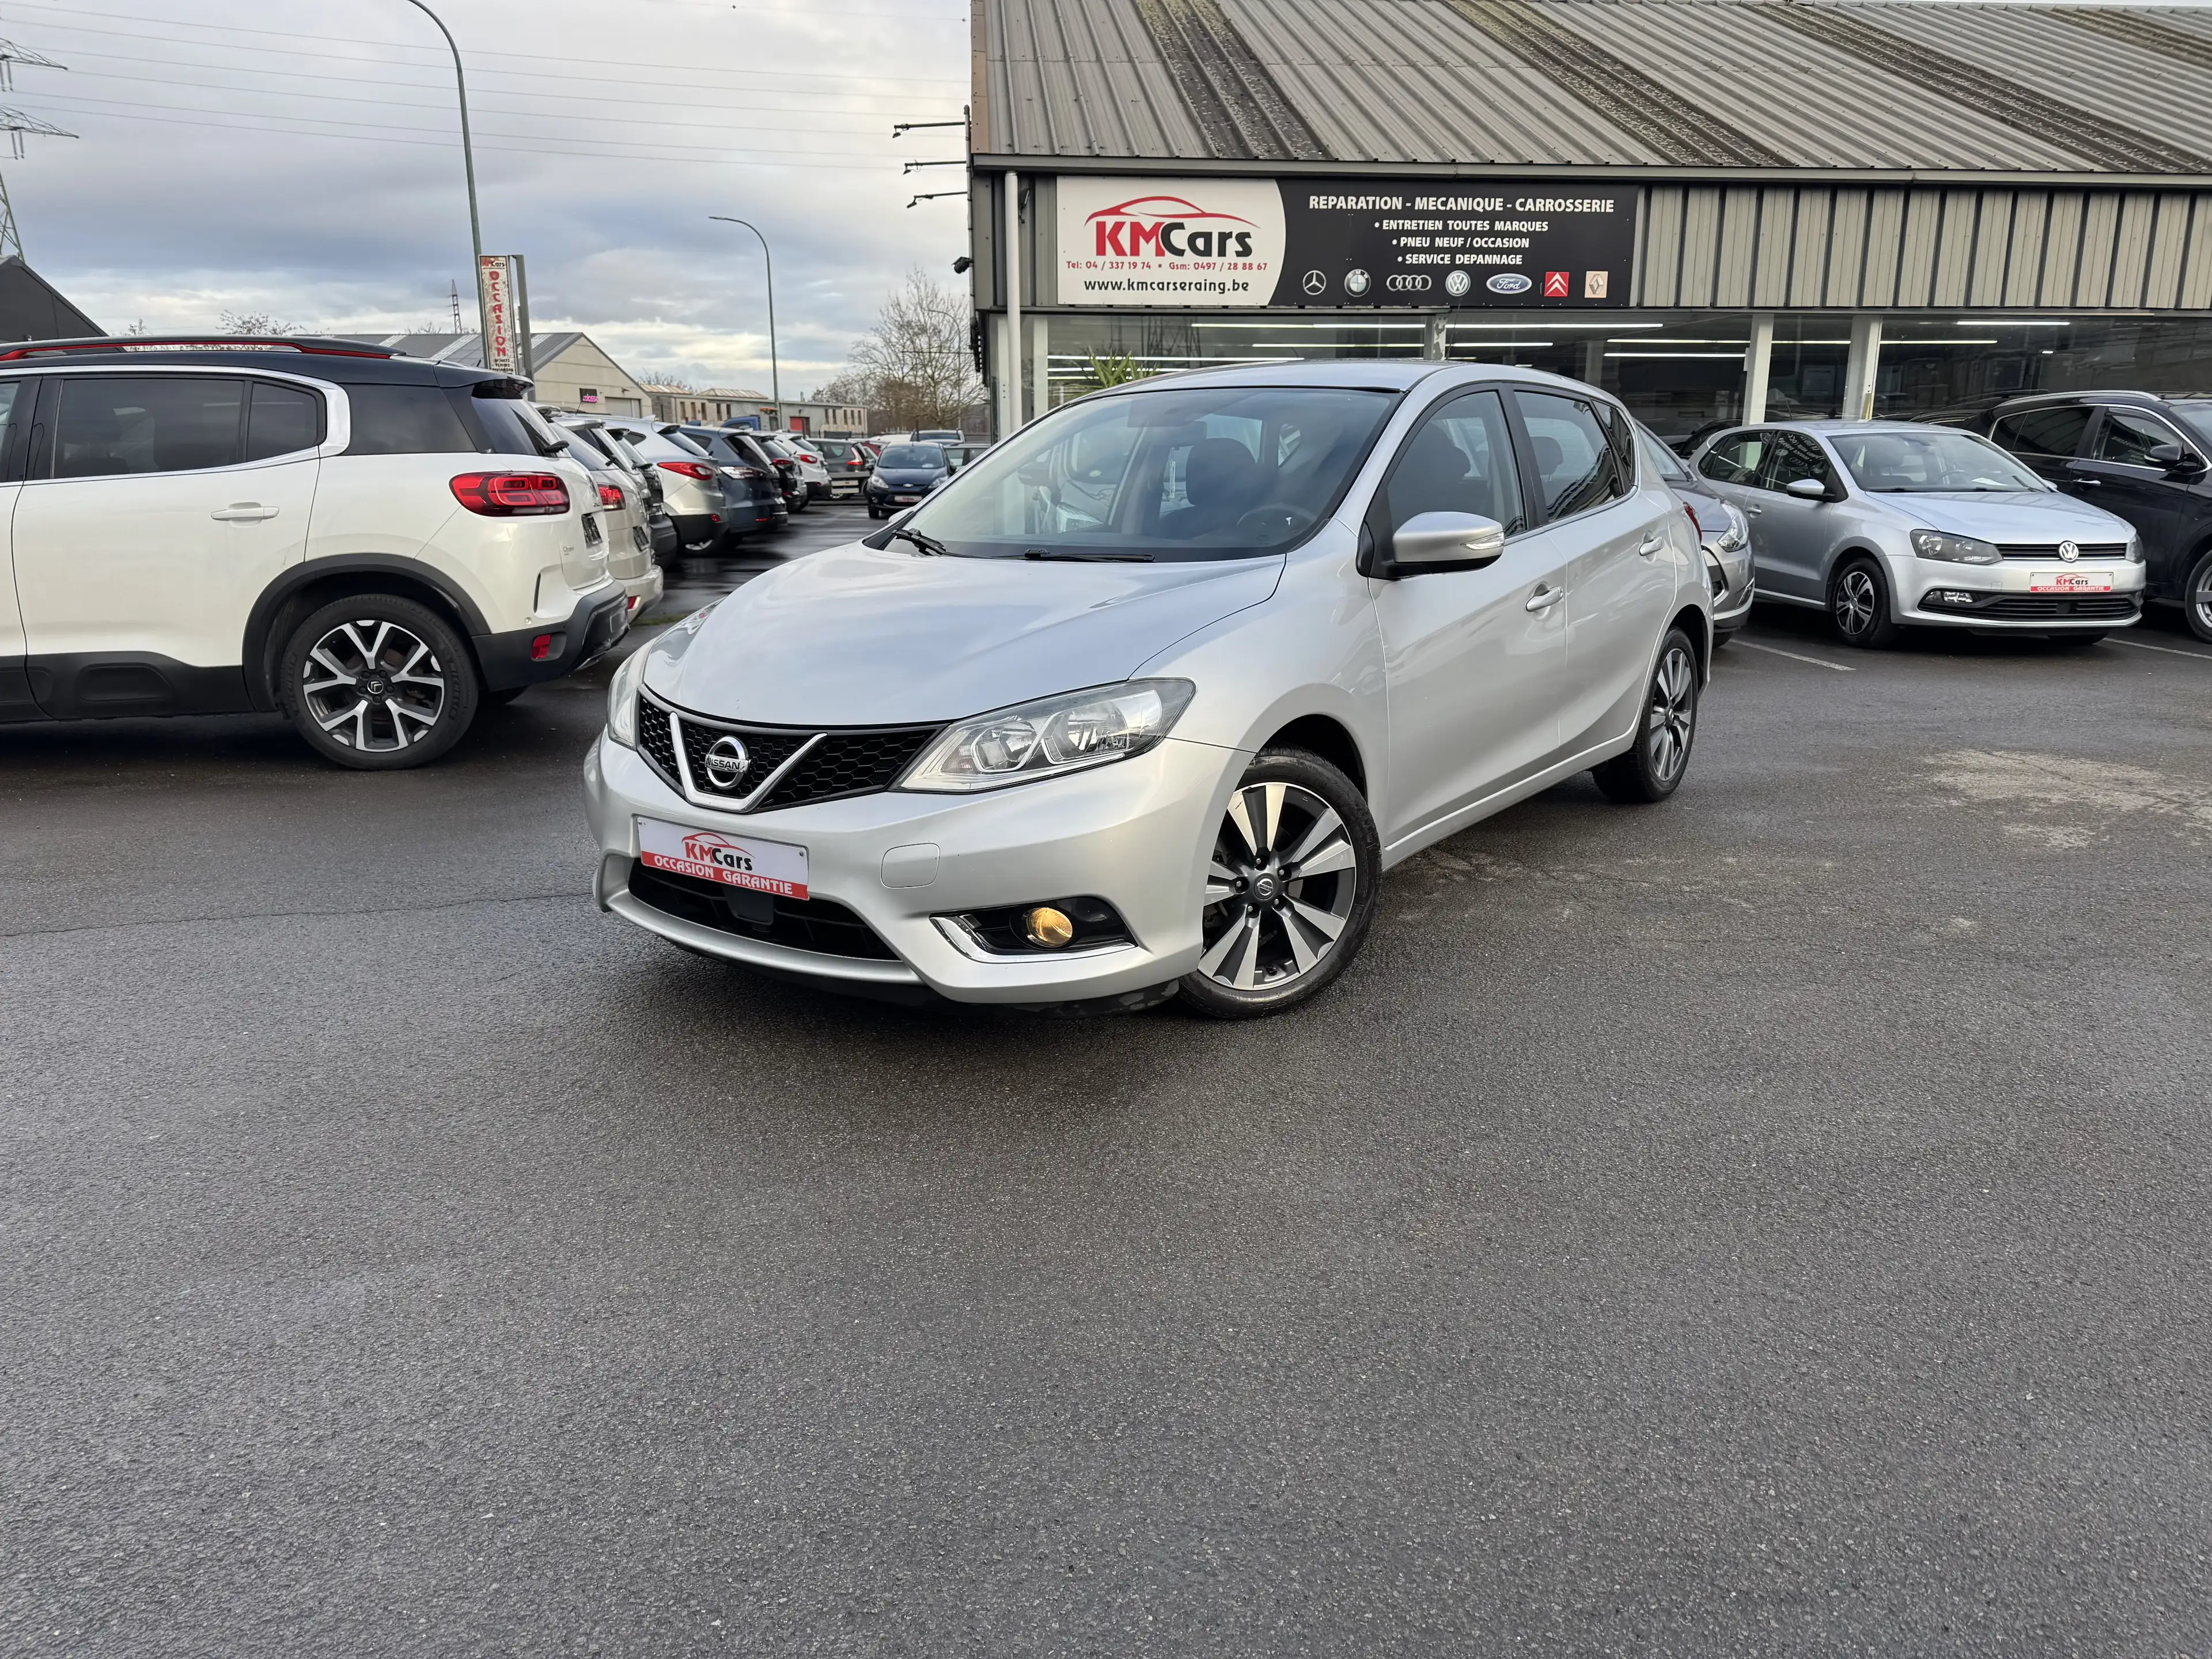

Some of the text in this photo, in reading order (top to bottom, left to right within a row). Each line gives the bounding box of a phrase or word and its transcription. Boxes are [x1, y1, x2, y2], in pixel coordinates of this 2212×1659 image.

[1309, 196, 1402, 209] REPARATION
[1414, 197, 1503, 213] MECANIQUE
[1515, 198, 1614, 213] CARROSSERIE
[1382, 219, 1548, 232] ENTRETIEN TOUTES MARQUES
[1096, 221, 1253, 257] KMCars
[1400, 237, 1430, 247] PNEU
[1435, 237, 1464, 247] NEUF
[1472, 237, 1529, 248] OCCASION
[1066, 261, 1082, 269] Tel:
[1085, 261, 1097, 269] 04
[1109, 262, 1124, 270] 337
[1127, 262, 1137, 270] 19
[1141, 262, 1151, 270] 74
[1169, 262, 1190, 270] Gsm:
[1194, 262, 1216, 270] 0497
[1227, 262, 1237, 270] 28
[1257, 263, 1267, 271] 67
[1405, 254, 1522, 264] SERVICE DEPANNAGE
[1084, 278, 1249, 294] www.kmcarseraing.be
[1497, 278, 1521, 290] Ford
[489, 271, 506, 357] OCCASION
[706, 754, 740, 771] NISSAN
[685, 841, 753, 872] KMCars
[654, 855, 793, 895] OCCASION GARANTIE
